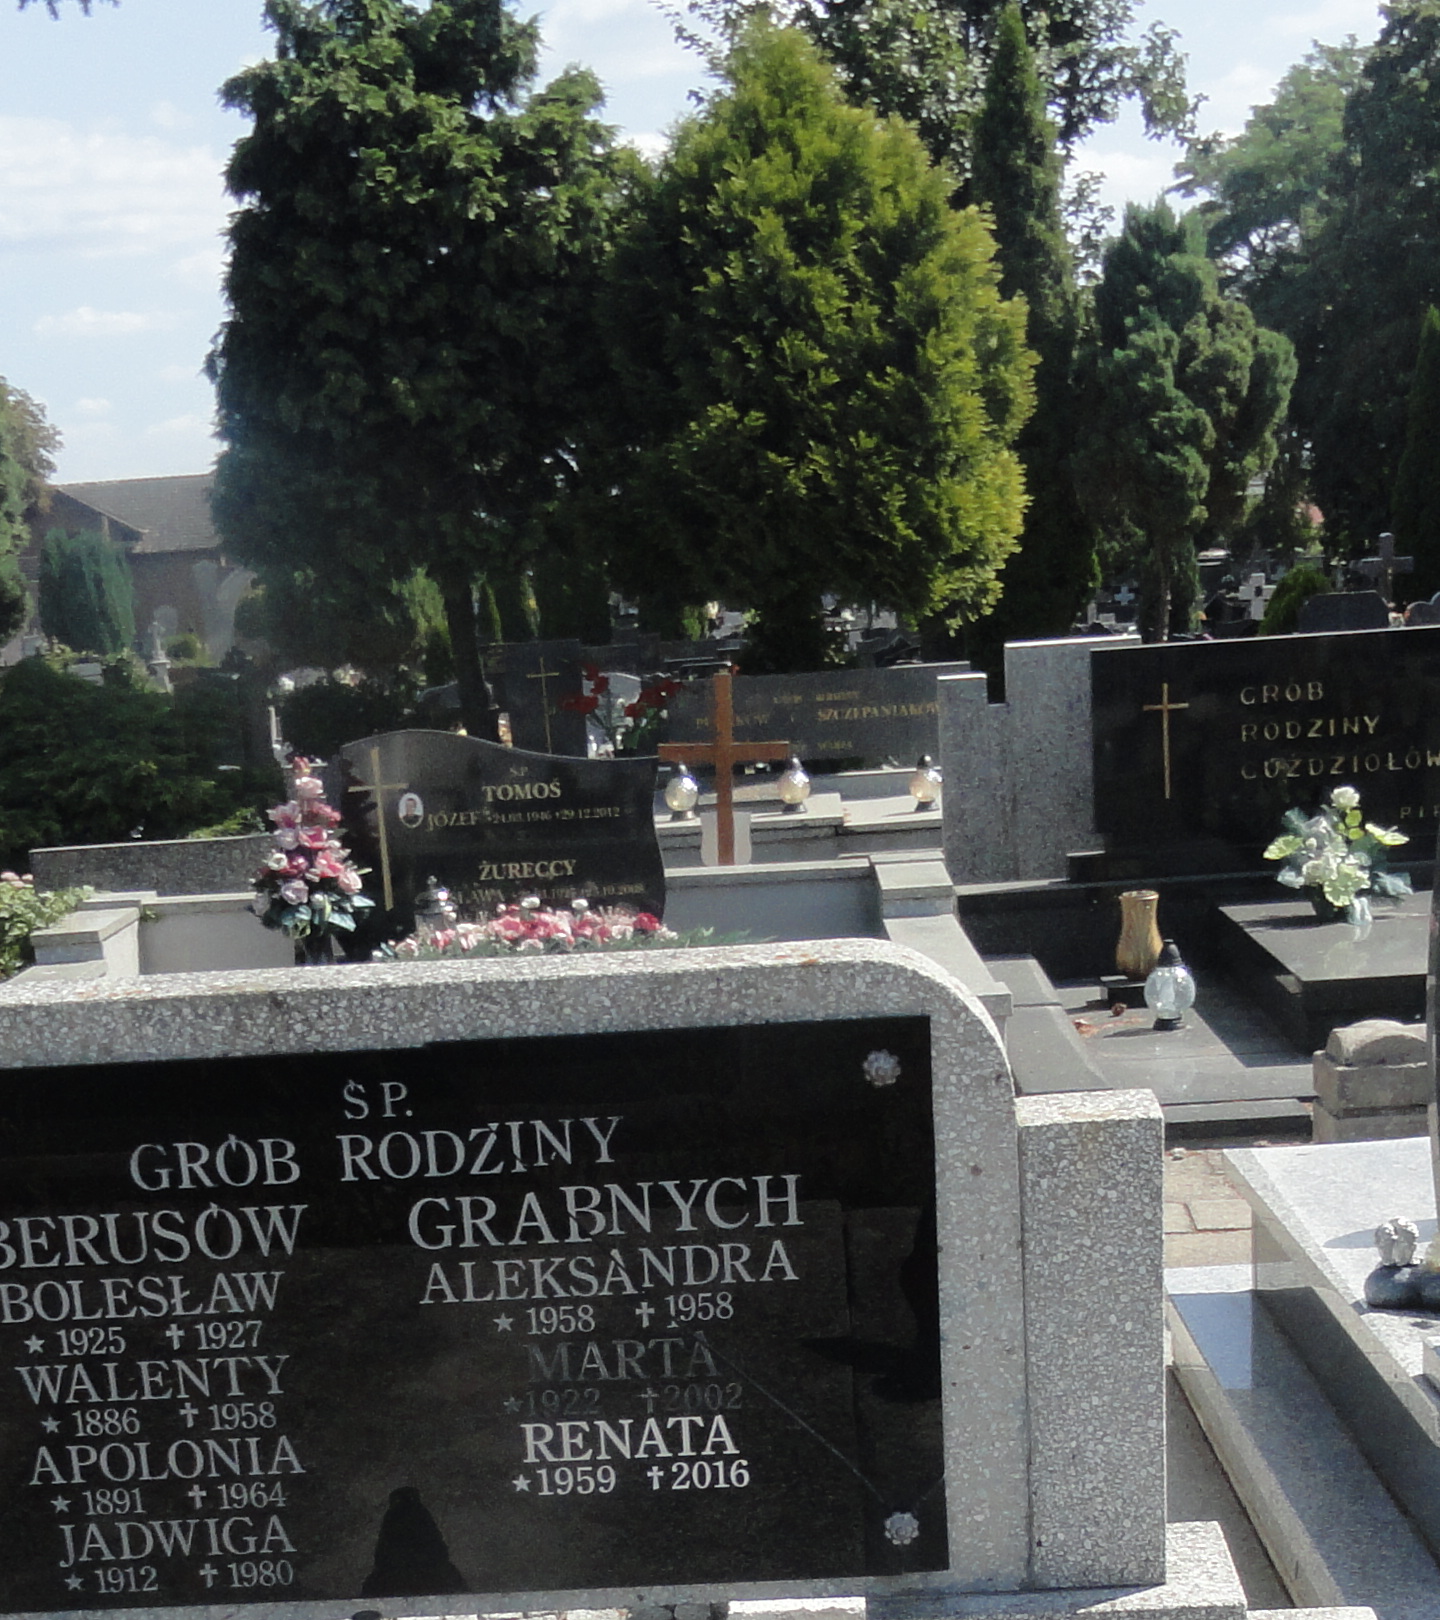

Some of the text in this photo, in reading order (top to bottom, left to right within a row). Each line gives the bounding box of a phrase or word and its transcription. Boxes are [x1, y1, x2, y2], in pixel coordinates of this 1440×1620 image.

[1241, 716, 1380, 742] RODZINY
[482, 778, 562, 802] TOMOŚ
[479, 859, 577, 881] ŻURECCY
[129, 1115, 624, 1191] GRÓB RODZINY
[408, 1174, 805, 1250] GRABNYCH
[418, 1239, 800, 1305] ALEKSANDRA
[526, 1304, 596, 1335] 1958
[56, 1320, 263, 1357] 1925 1927
[522, 1330, 722, 1382] MARTA
[14, 1354, 290, 1405] WALENTY
[71, 1401, 277, 1437] 1886 1958
[520, 1414, 741, 1463] RENATA
[28, 1435, 307, 1486] APOLONIA
[536, 1459, 750, 1496] 1959 2016
[82, 1481, 288, 1516] 1891 1964
[59, 1514, 298, 1568] JADWIGA
[94, 1559, 294, 1594] 1912 1980
